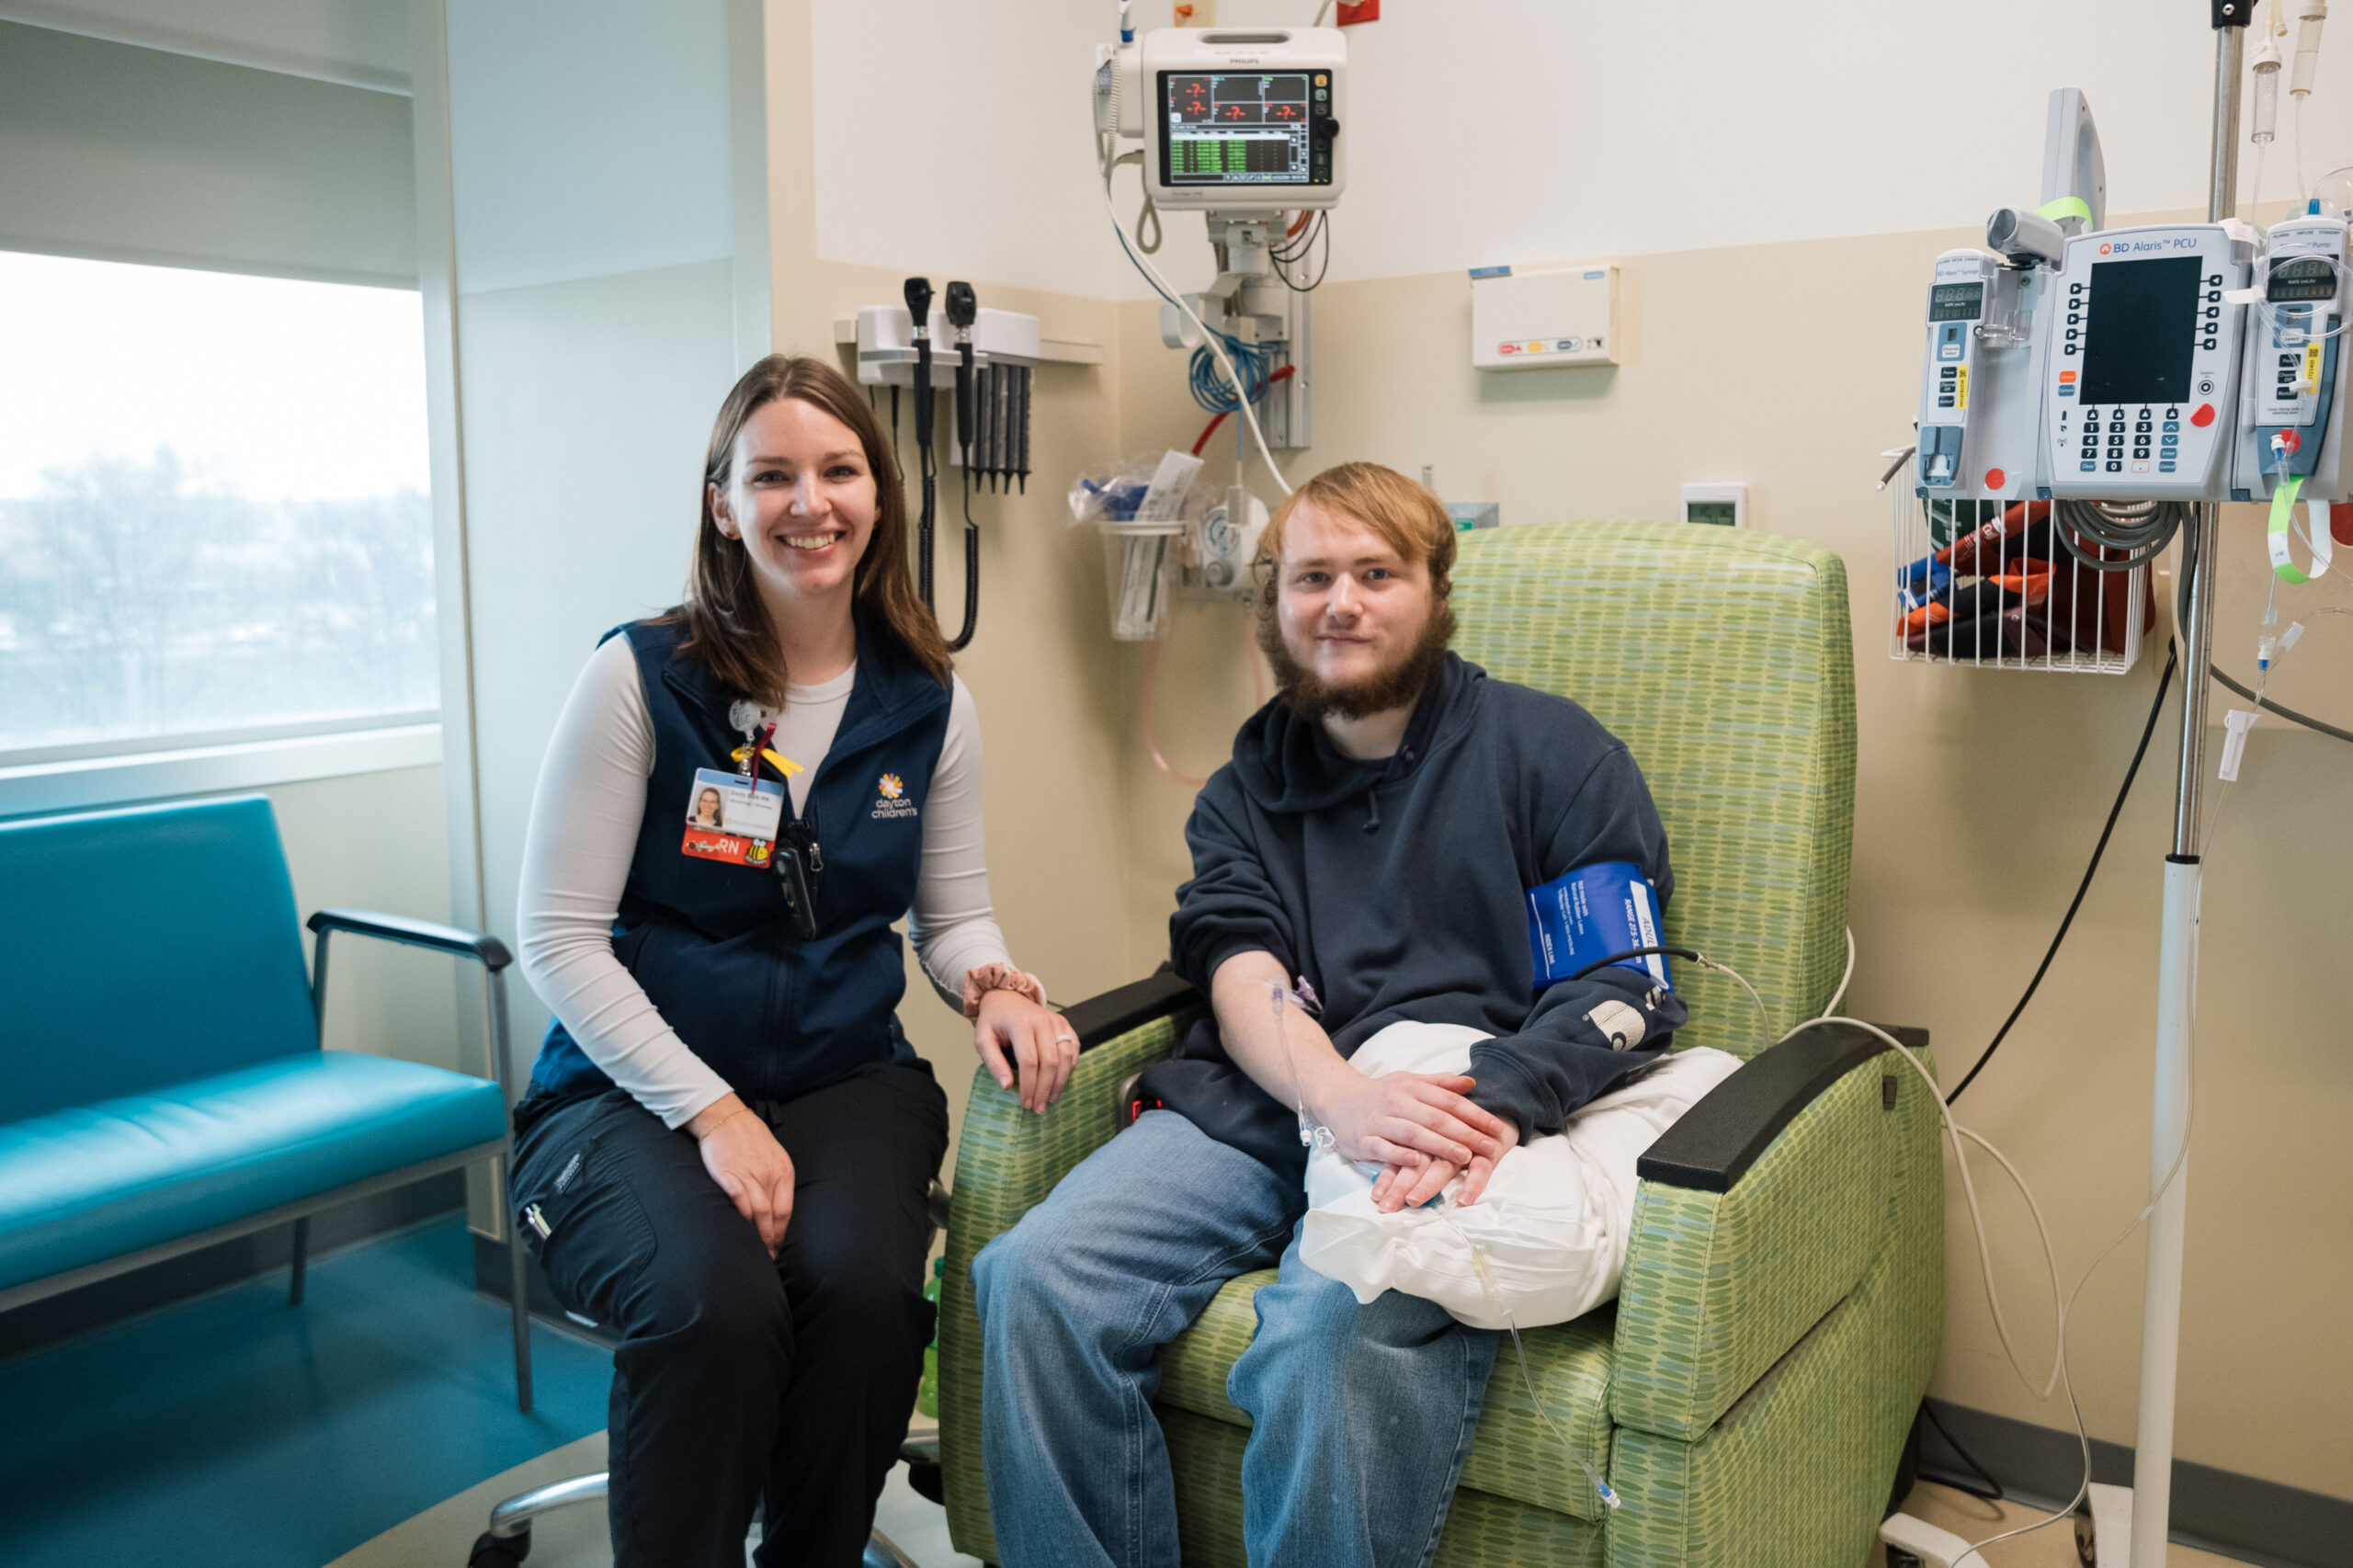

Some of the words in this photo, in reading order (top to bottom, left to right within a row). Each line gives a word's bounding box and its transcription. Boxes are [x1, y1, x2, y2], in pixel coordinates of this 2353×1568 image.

[2113, 243, 2130, 254] BD
[2173, 238, 2197, 249] PCU
[2110, 462, 2117, 471] 0
[871, 806, 918, 818] children's
[876, 798, 912, 810] dayton
[720, 838, 740, 856] RN
[1571, 881, 1580, 901] Natural
[1574, 901, 1582, 919] Rubber
[1624, 898, 1636, 923] RANGE
[1545, 933, 1553, 951] INDEX
